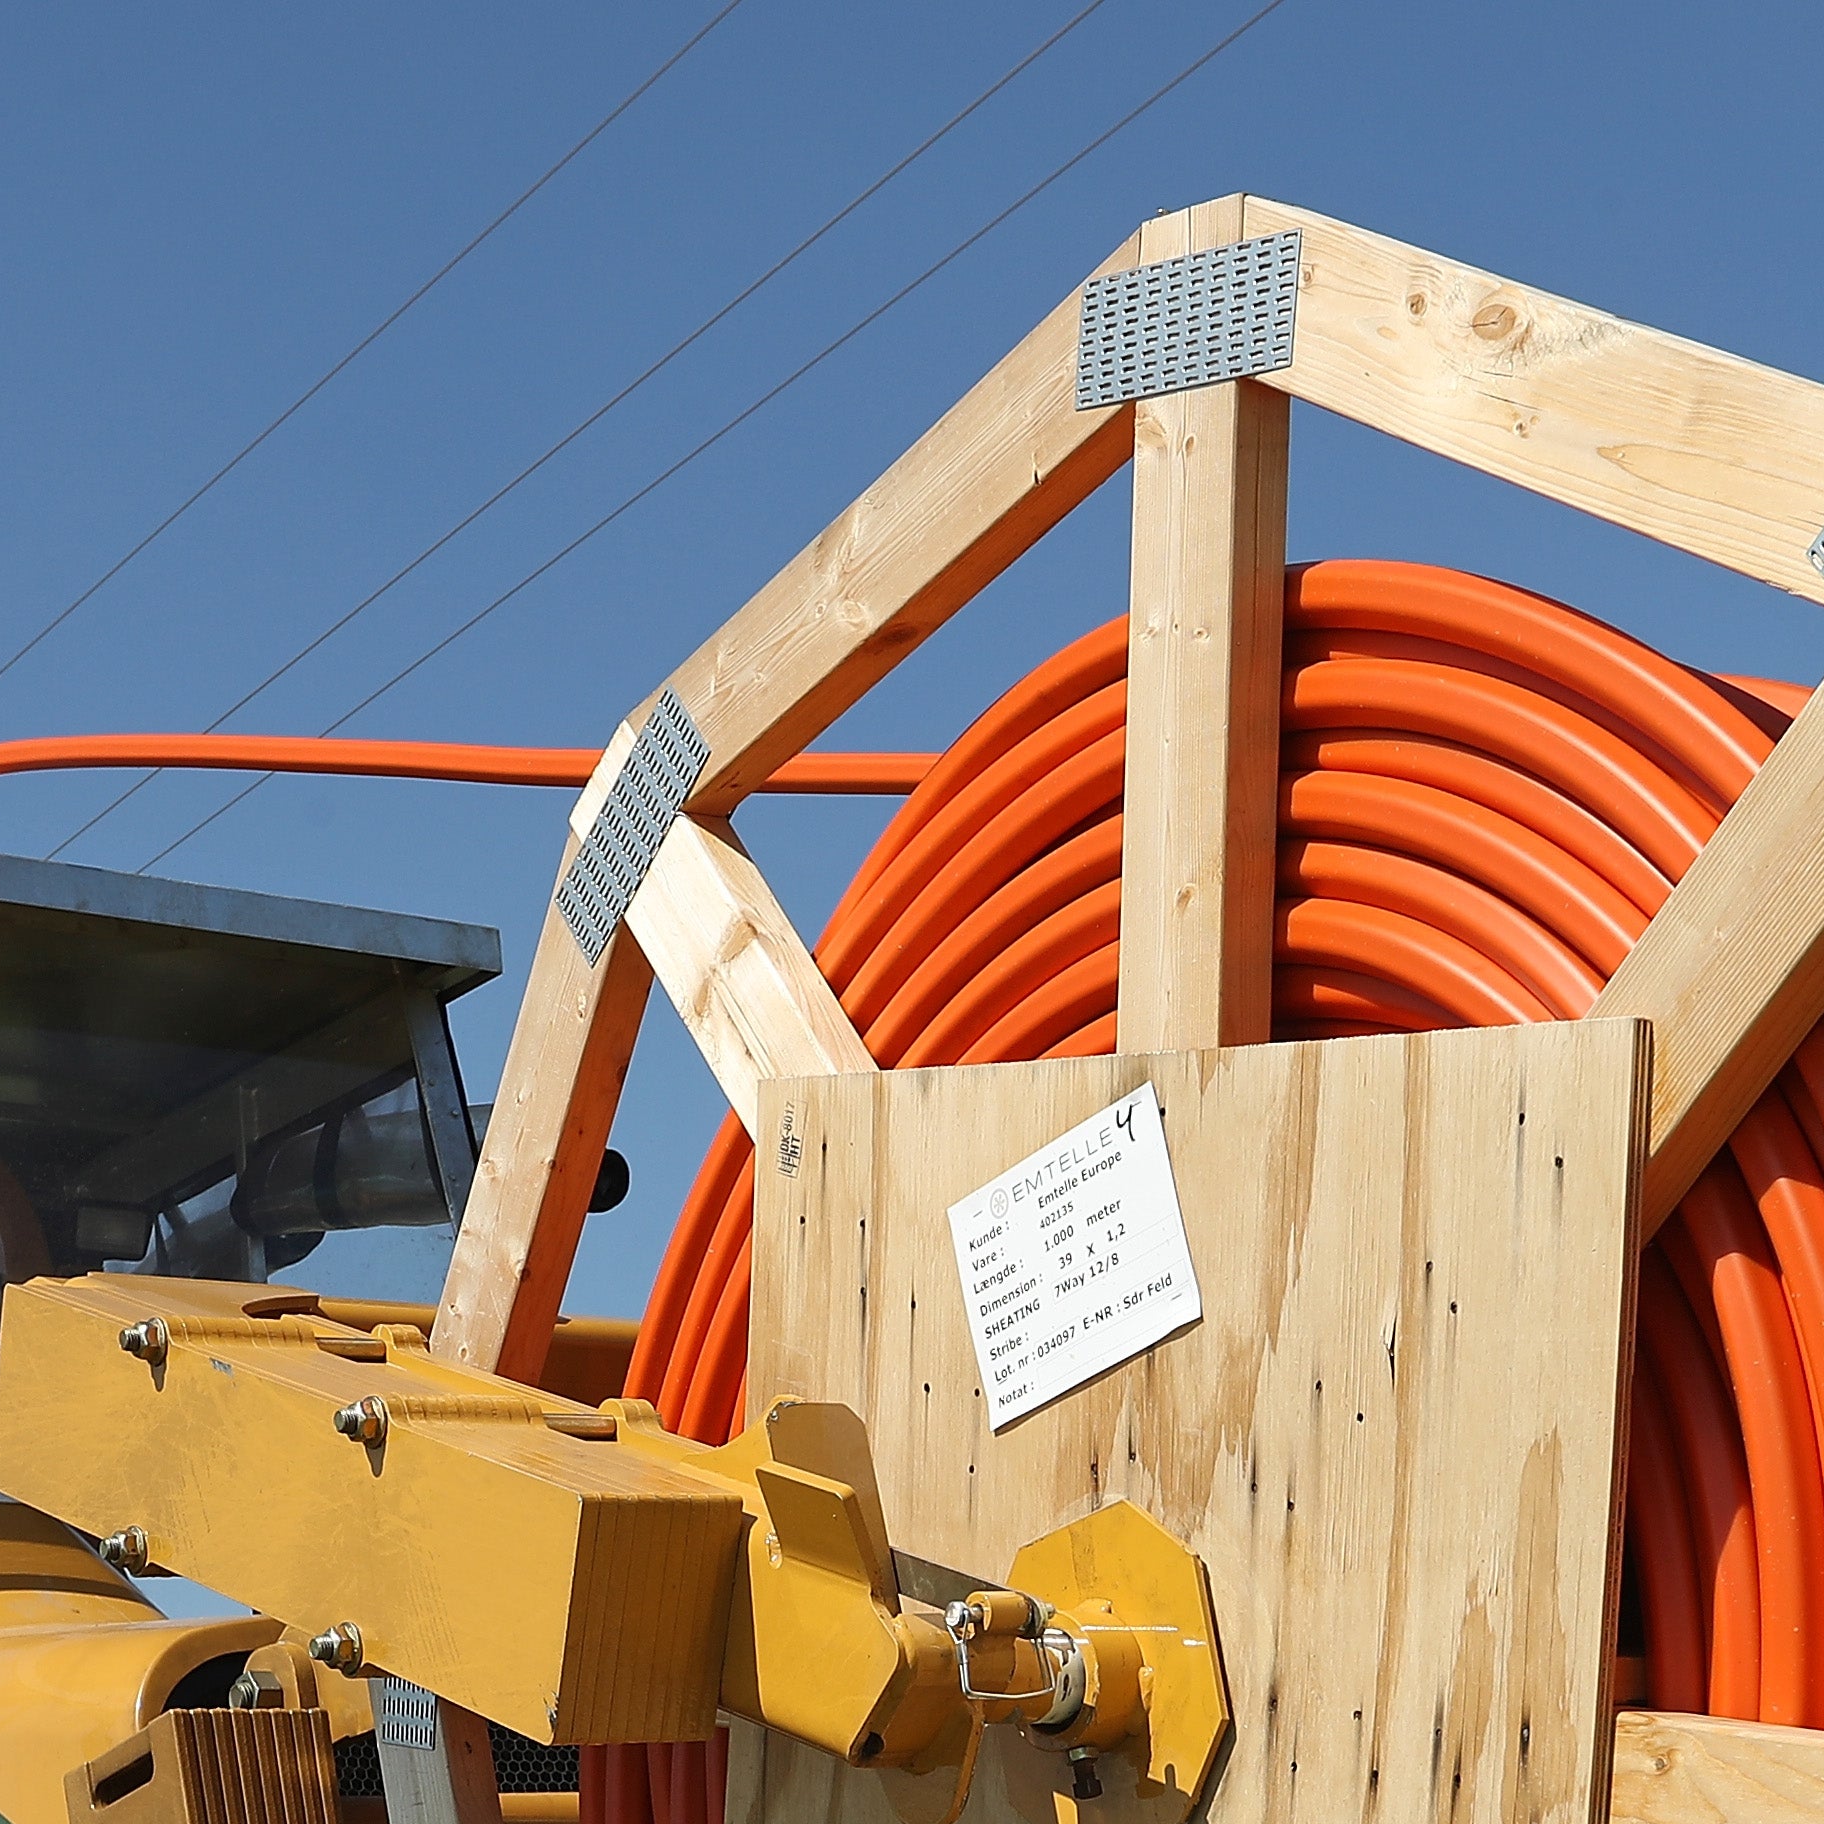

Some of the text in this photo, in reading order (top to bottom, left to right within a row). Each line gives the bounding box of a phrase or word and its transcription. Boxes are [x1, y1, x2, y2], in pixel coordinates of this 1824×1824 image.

[779, 1101, 795, 1153] DK-8017
[790, 1135, 801, 1155] HT
[1116, 1104, 1136, 1142] 4
[1012, 1126, 1113, 1203] EMTELLE
[1037, 1176, 1078, 1209] Emtelle
[1081, 1150, 1122, 1182] Europe
[1039, 1200, 1074, 1229] 402135
[1045, 1224, 1074, 1252] 1.000
[1086, 1199, 1121, 1227] meter
[1058, 1253, 1073, 1269] 39
[1107, 1223, 1126, 1242] 1,2
[984, 1253, 1119, 1340] SHEATING 7Way 12/8
[994, 1364, 1015, 1384] Lot.
[1037, 1325, 1075, 1358] 034097
[1083, 1305, 1113, 1330] E-NR
[1123, 1291, 1144, 1310] Sdr
[1147, 1273, 1172, 1297] Feld
